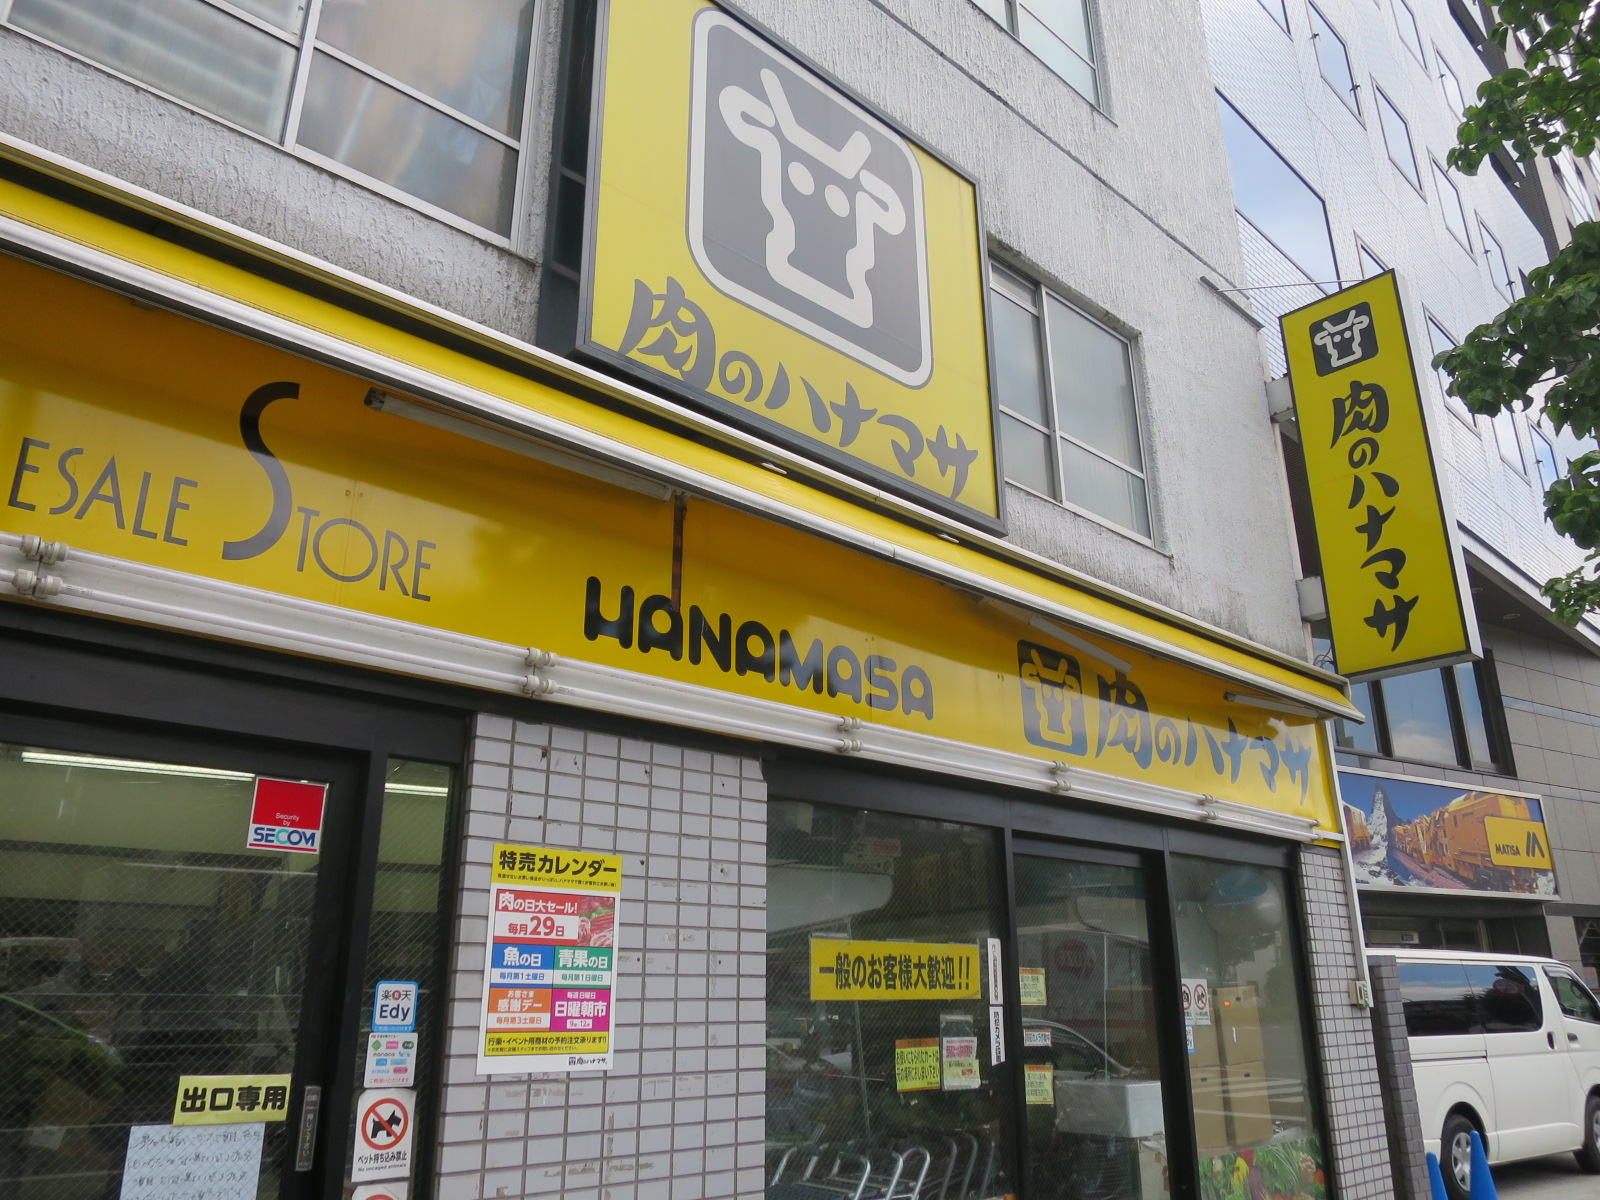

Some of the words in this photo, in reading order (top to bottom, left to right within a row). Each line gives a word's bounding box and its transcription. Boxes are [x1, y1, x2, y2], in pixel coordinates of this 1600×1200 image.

[618, 276, 979, 501] 肉のハナマサ
[8, 437, 199, 547] ESALE
[221, 381, 437, 602] STORE
[1330, 380, 1420, 652] 肉のハナマサ
[584, 576, 934, 721] HANAMASA
[1095, 668, 1312, 807] 肉のハナマサ
[275, 812, 300, 822] Security
[282, 819, 291, 827] by
[253, 826, 316, 847] SECOM
[1495, 843, 1521, 856] MATISA
[499, 850, 617, 877] 特売カレンダー
[498, 891, 578, 914] 肉の日大セール!
[508, 915, 565, 937] 毎月29日
[503, 946, 542, 967] 魚の日
[558, 949, 608, 969] 青果の日
[499, 972, 545, 981] 毎月第1土曜日
[561, 973, 604, 982] 毎月第1日曜日
[818, 951, 971, 991] 一般のお客様大歓迎!!
[507, 990, 534, 998] お客さま
[379, 1003, 411, 1022] Edy
[497, 999, 543, 1012] 感謝デー
[554, 1000, 607, 1018] 日曜朝市
[496, 1016, 543, 1025] 毎月第3土曜日
[180, 1085, 288, 1113] 出口専用
[357, 1150, 408, 1165] ペット持ち込み禁止
